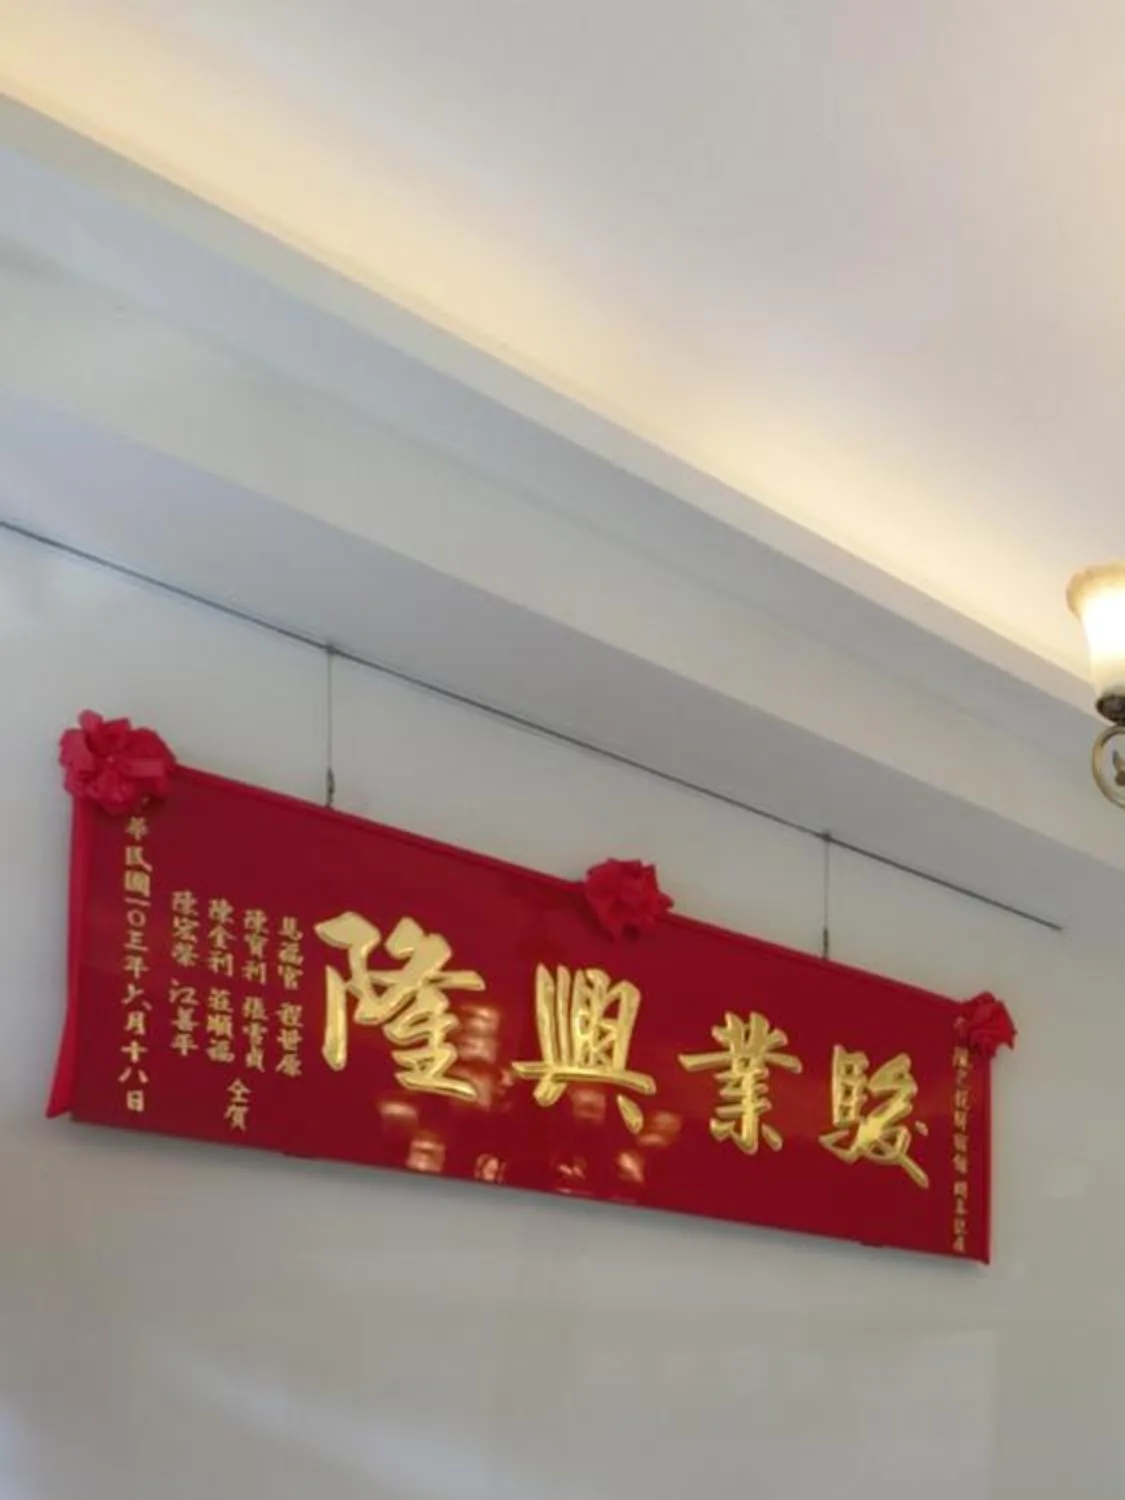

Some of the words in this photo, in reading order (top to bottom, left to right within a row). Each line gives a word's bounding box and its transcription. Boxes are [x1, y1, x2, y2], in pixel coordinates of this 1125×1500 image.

[118, 797, 154, 1113] 華民國一〇三年六月十八日
